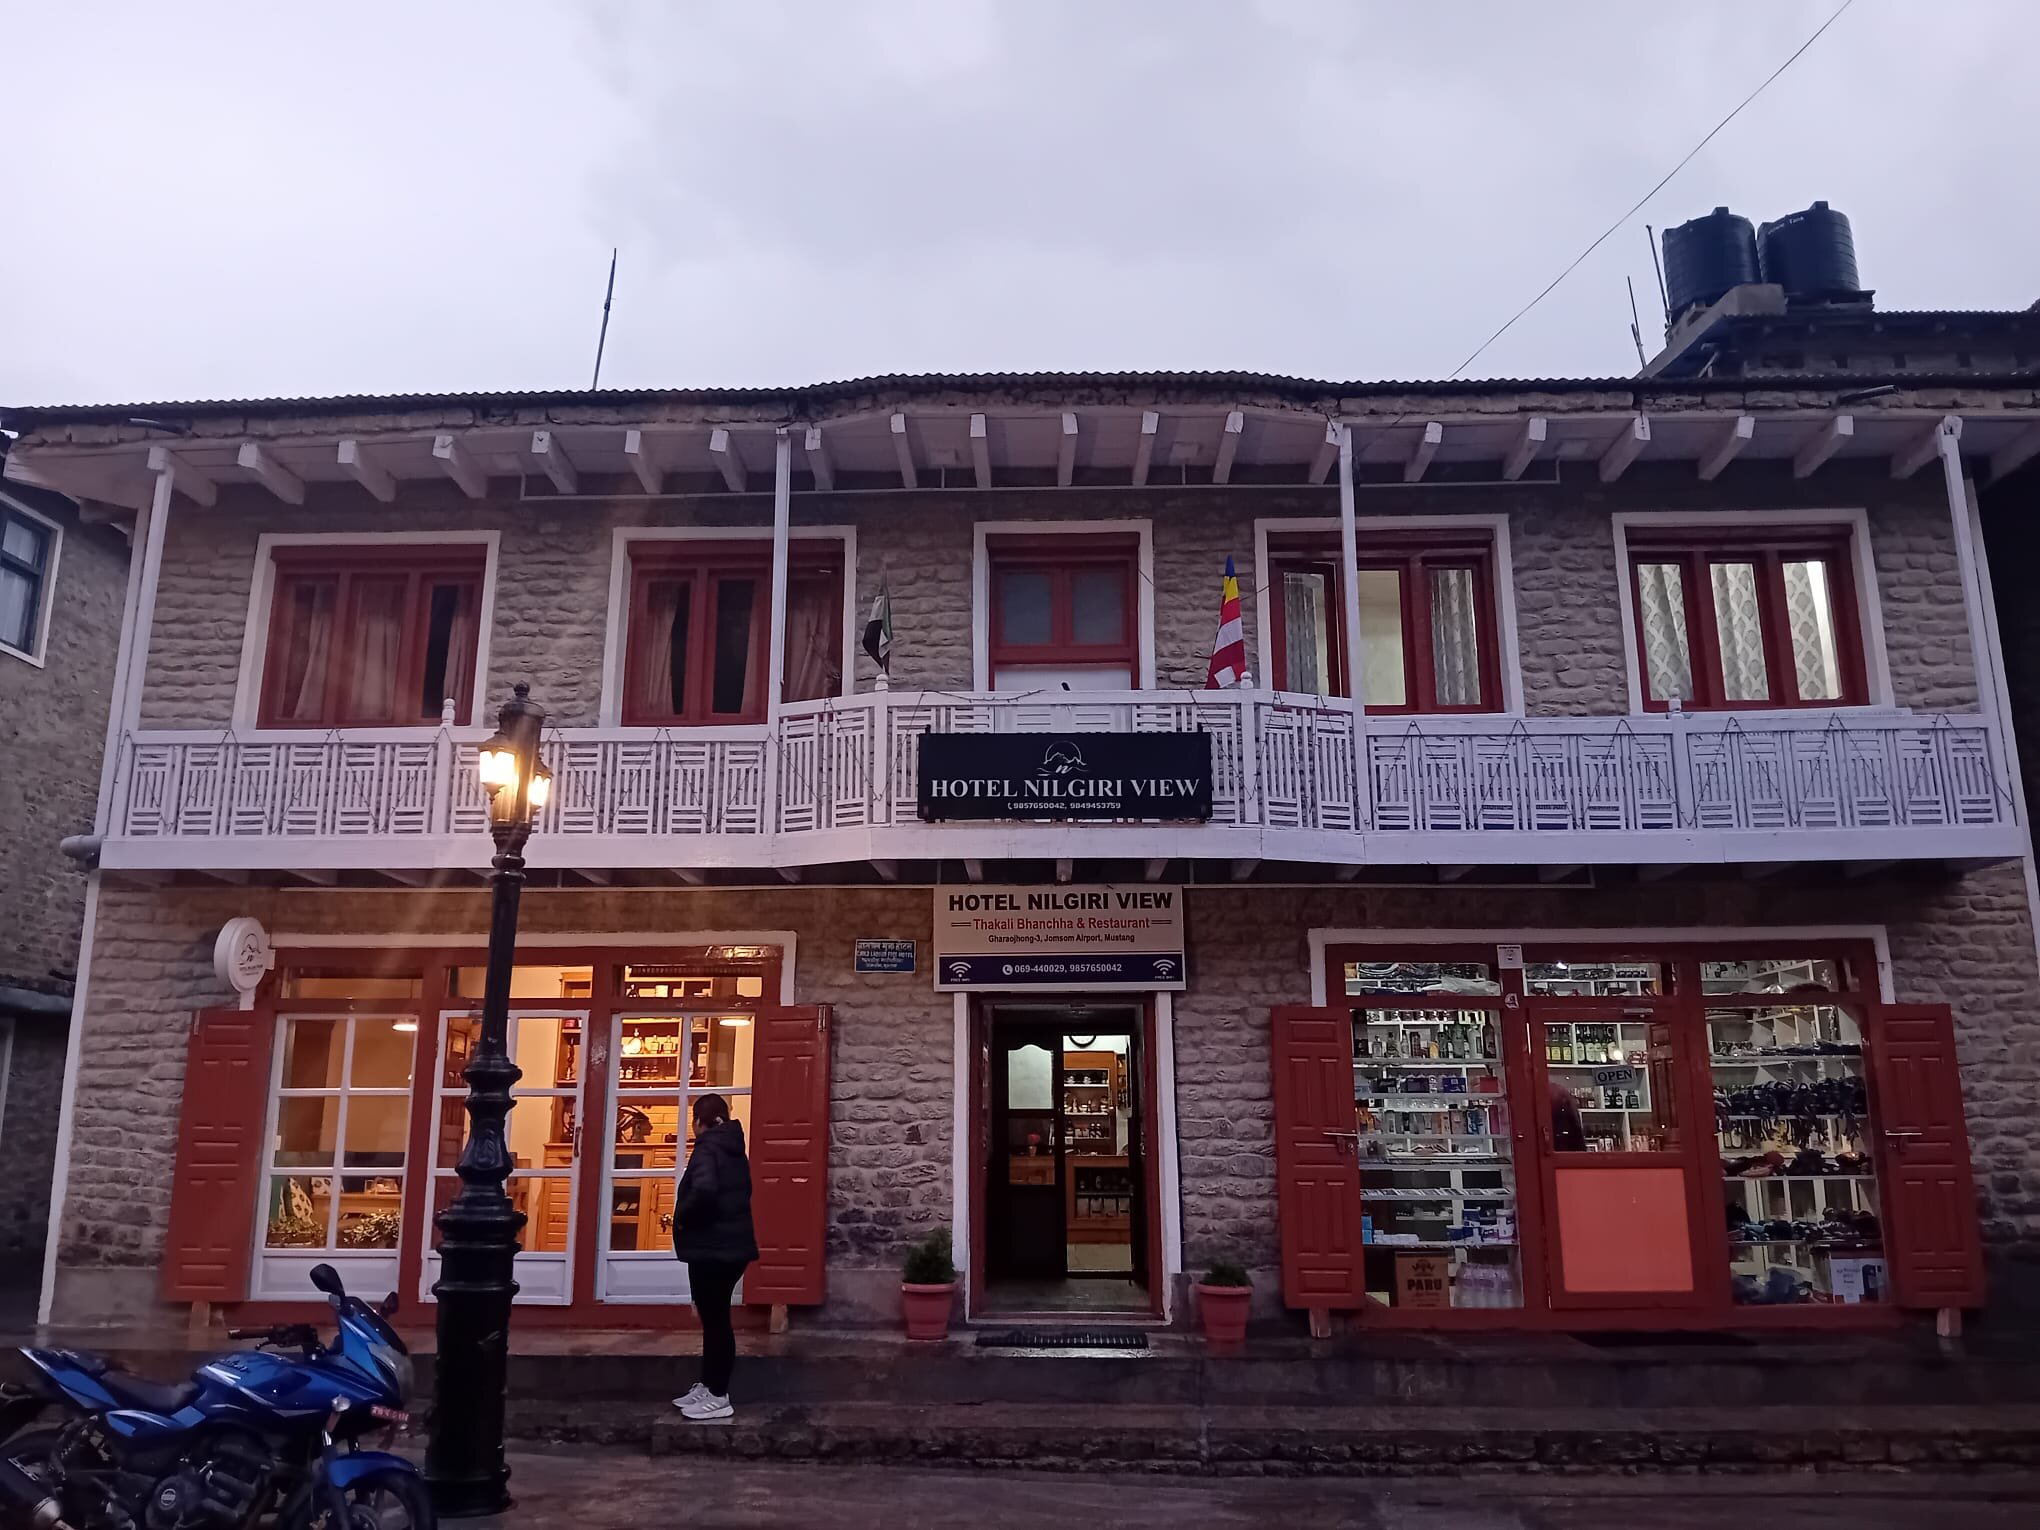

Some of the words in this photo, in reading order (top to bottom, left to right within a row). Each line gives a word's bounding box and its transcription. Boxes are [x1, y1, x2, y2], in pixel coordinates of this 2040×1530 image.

[931, 779, 1018, 798] HOTEL
[1023, 779, 1123, 797] NILGIRI
[1130, 778, 1200, 797] VIEW
[949, 894, 1021, 911] HOTEL
[1028, 893, 1109, 910] NILGIRI
[1115, 892, 1173, 909] VIEW
[973, 918, 1014, 930] Thakali
[1017, 918, 1074, 930] Bhanchha
[1076, 917, 1086, 929] &
[1088, 917, 1150, 929] Restaurant
[1044, 934, 1075, 942] Jomsom
[1104, 933, 1135, 943] Mustang
[1014, 964, 1068, 974] 069-440029,
[1070, 963, 1122, 973] 9857650042
[1597, 1069, 1633, 1082] OPEN
